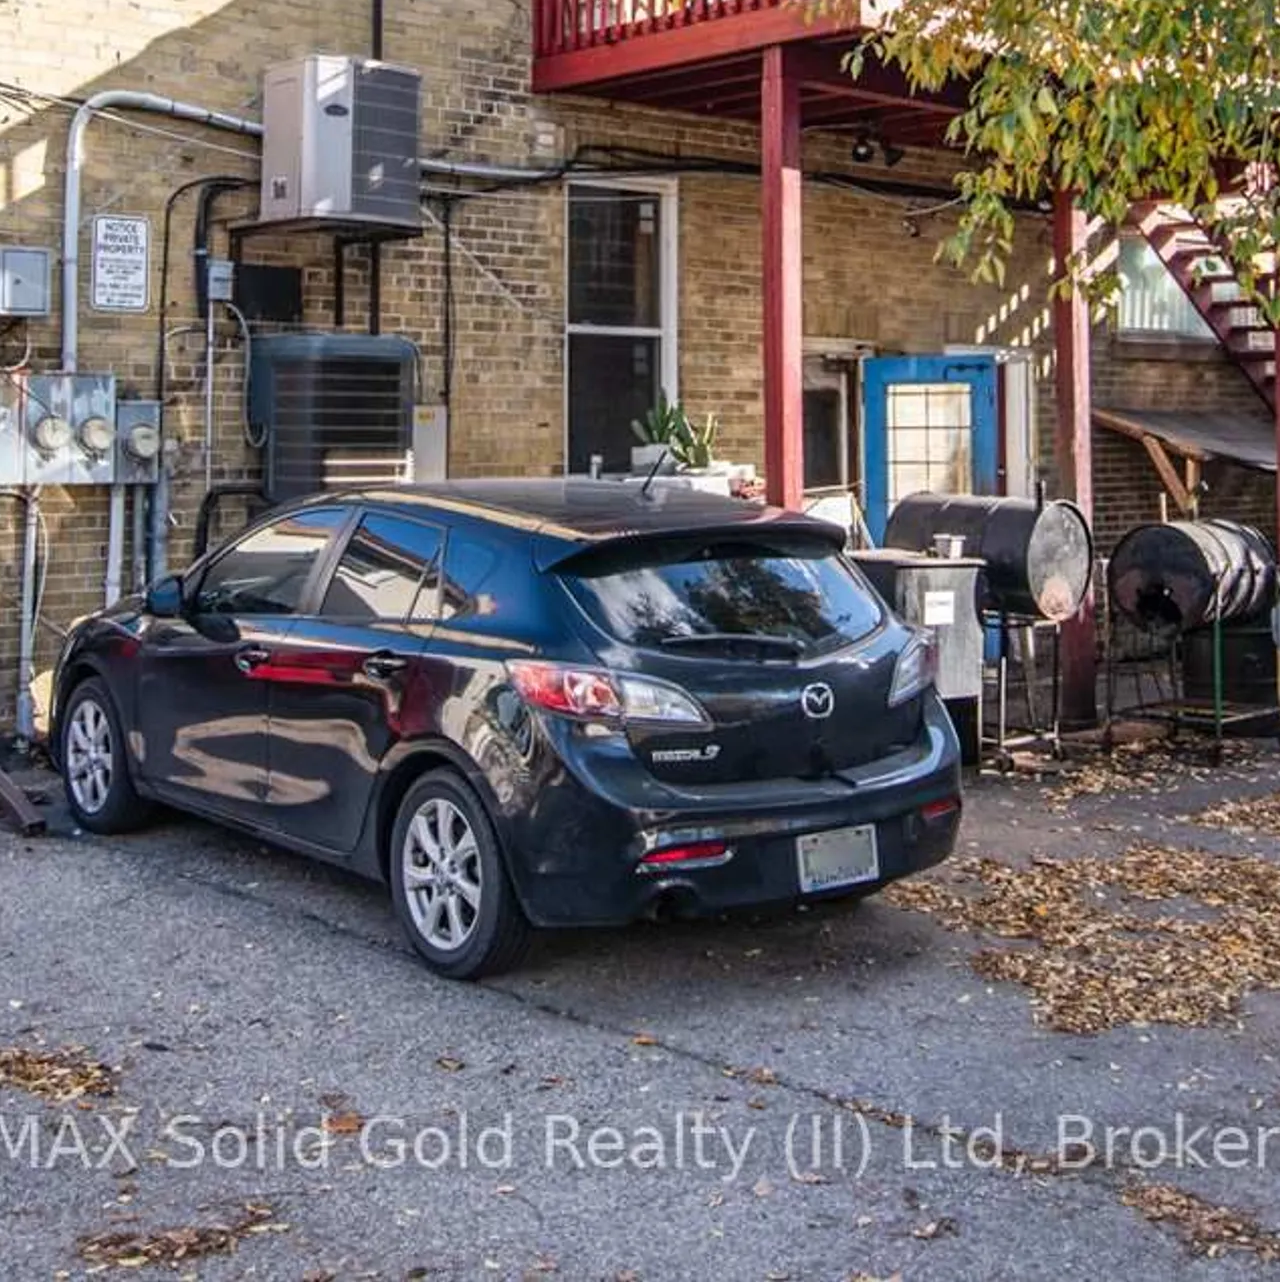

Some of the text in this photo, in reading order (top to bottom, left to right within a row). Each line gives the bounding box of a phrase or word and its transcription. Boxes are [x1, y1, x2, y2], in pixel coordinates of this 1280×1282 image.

[105, 222, 137, 233] NOTICE
[103, 233, 140, 244] PRIVATE
[99, 245, 145, 254] PROPERTY
